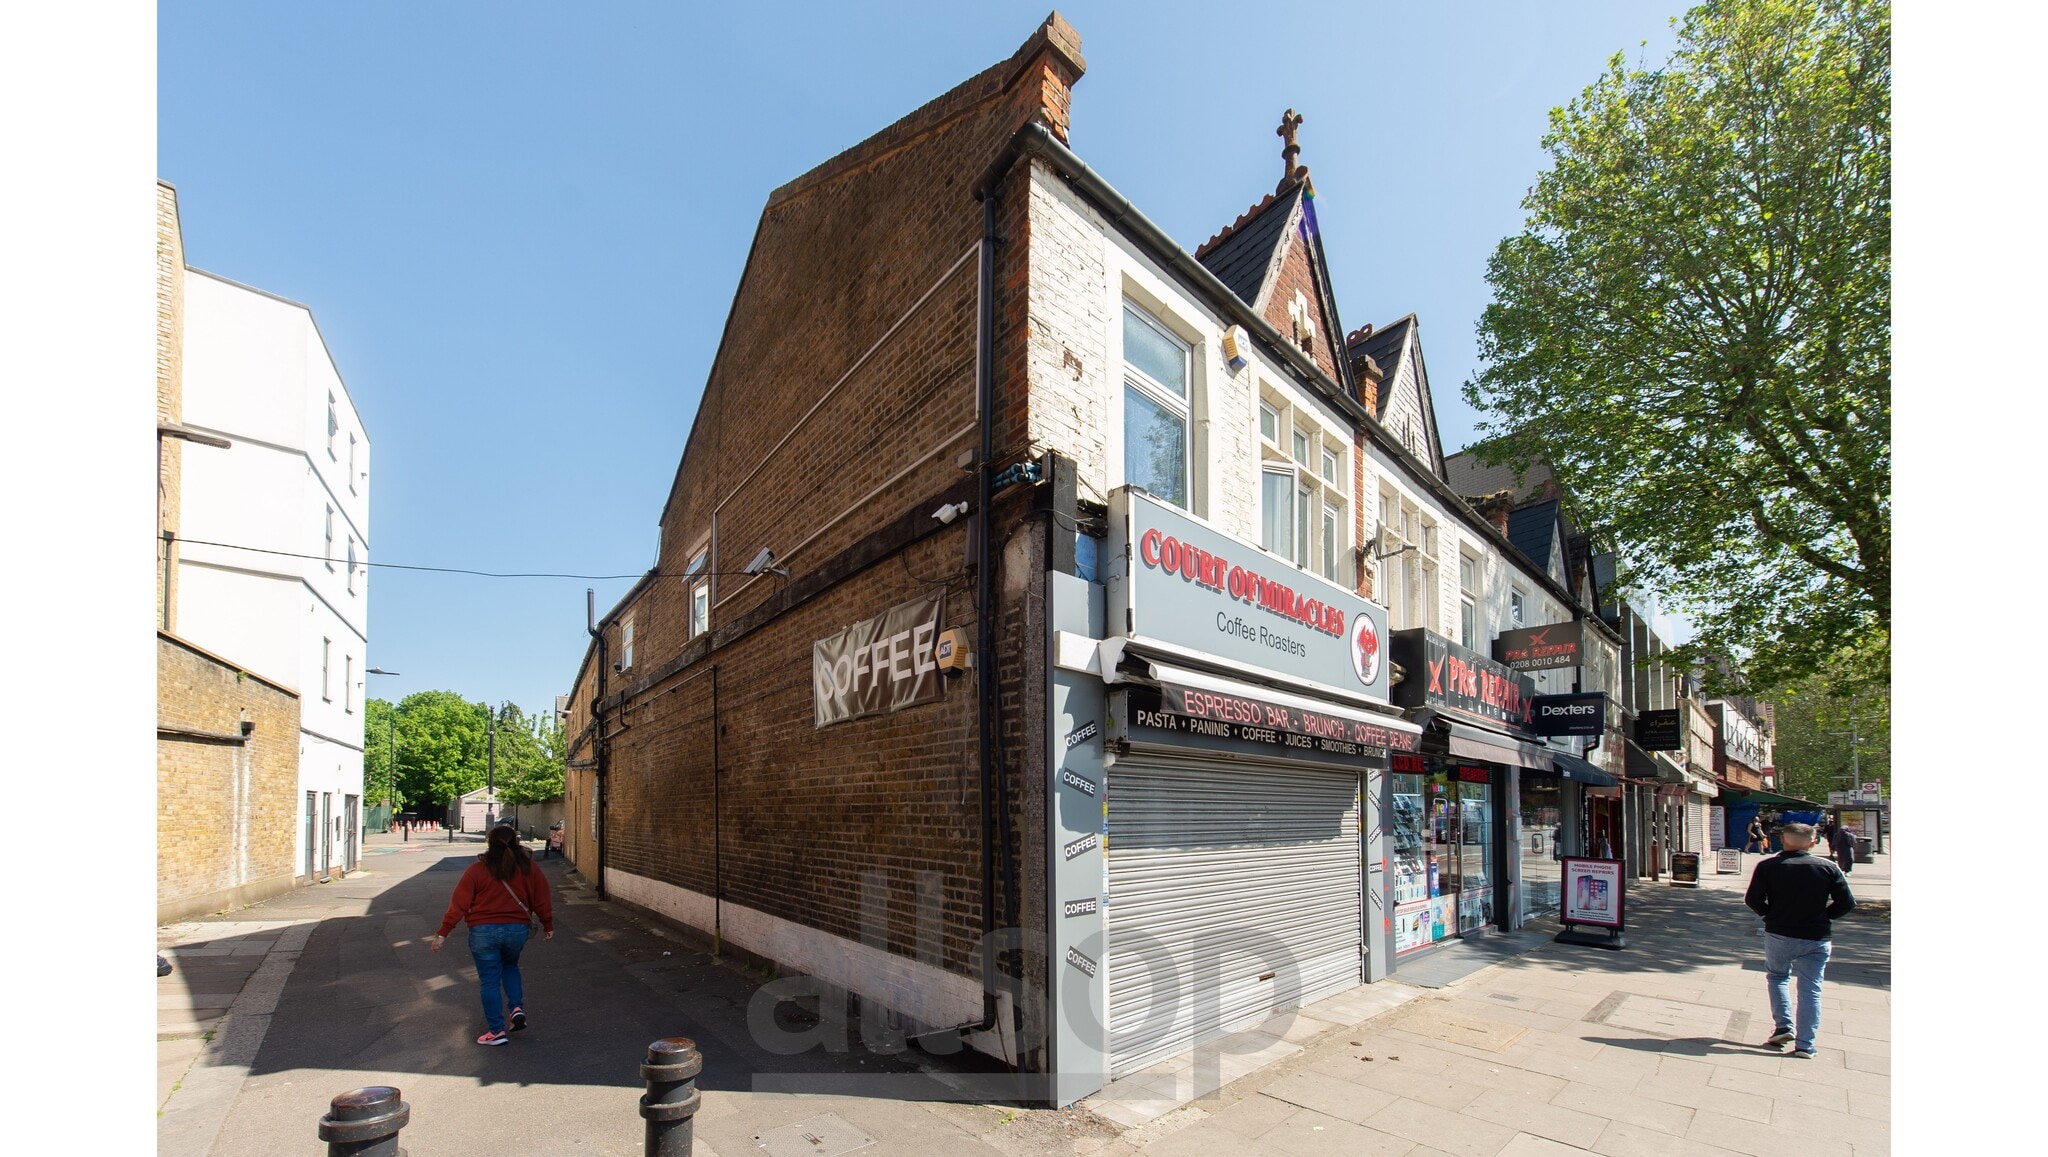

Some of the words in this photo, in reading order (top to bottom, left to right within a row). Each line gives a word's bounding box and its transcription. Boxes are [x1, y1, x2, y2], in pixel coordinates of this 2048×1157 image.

[1141, 528, 1228, 595] COURT
[1257, 576, 1345, 640] MIRACLES
[1216, 611, 1257, 642] Coffee
[1259, 625, 1306, 658] Roasters
[817, 620, 936, 701] COFFEE
[1510, 660, 1530, 669] 0208
[1531, 658, 1552, 666] 0010
[1554, 655, 1571, 663] 484
[1531, 642, 1577, 657] REPAIR
[1480, 668, 1521, 715] REPAIR
[1184, 690, 1262, 724] ESPRESSO
[1266, 706, 1291, 729] BAR
[1302, 713, 1345, 740] BRUNCH
[1354, 722, 1387, 746] COFFEE
[1389, 730, 1413, 751] BEANS
[1541, 704, 1596, 717] Dexters
[1065, 724, 1097, 748] COFFEE
[1137, 710, 1177, 730] PASTA
[1190, 718, 1231, 738] PANINIS
[1241, 726, 1277, 744] COFFEE
[1284, 734, 1313, 749] JUICES
[1320, 739, 1358, 756] SMOOTHIES
[1063, 771, 1096, 796] COFFEE
[1065, 833, 1097, 858] COFFEE
[1064, 899, 1097, 915] COFFEE
[1067, 951, 1096, 976] COFFEE
